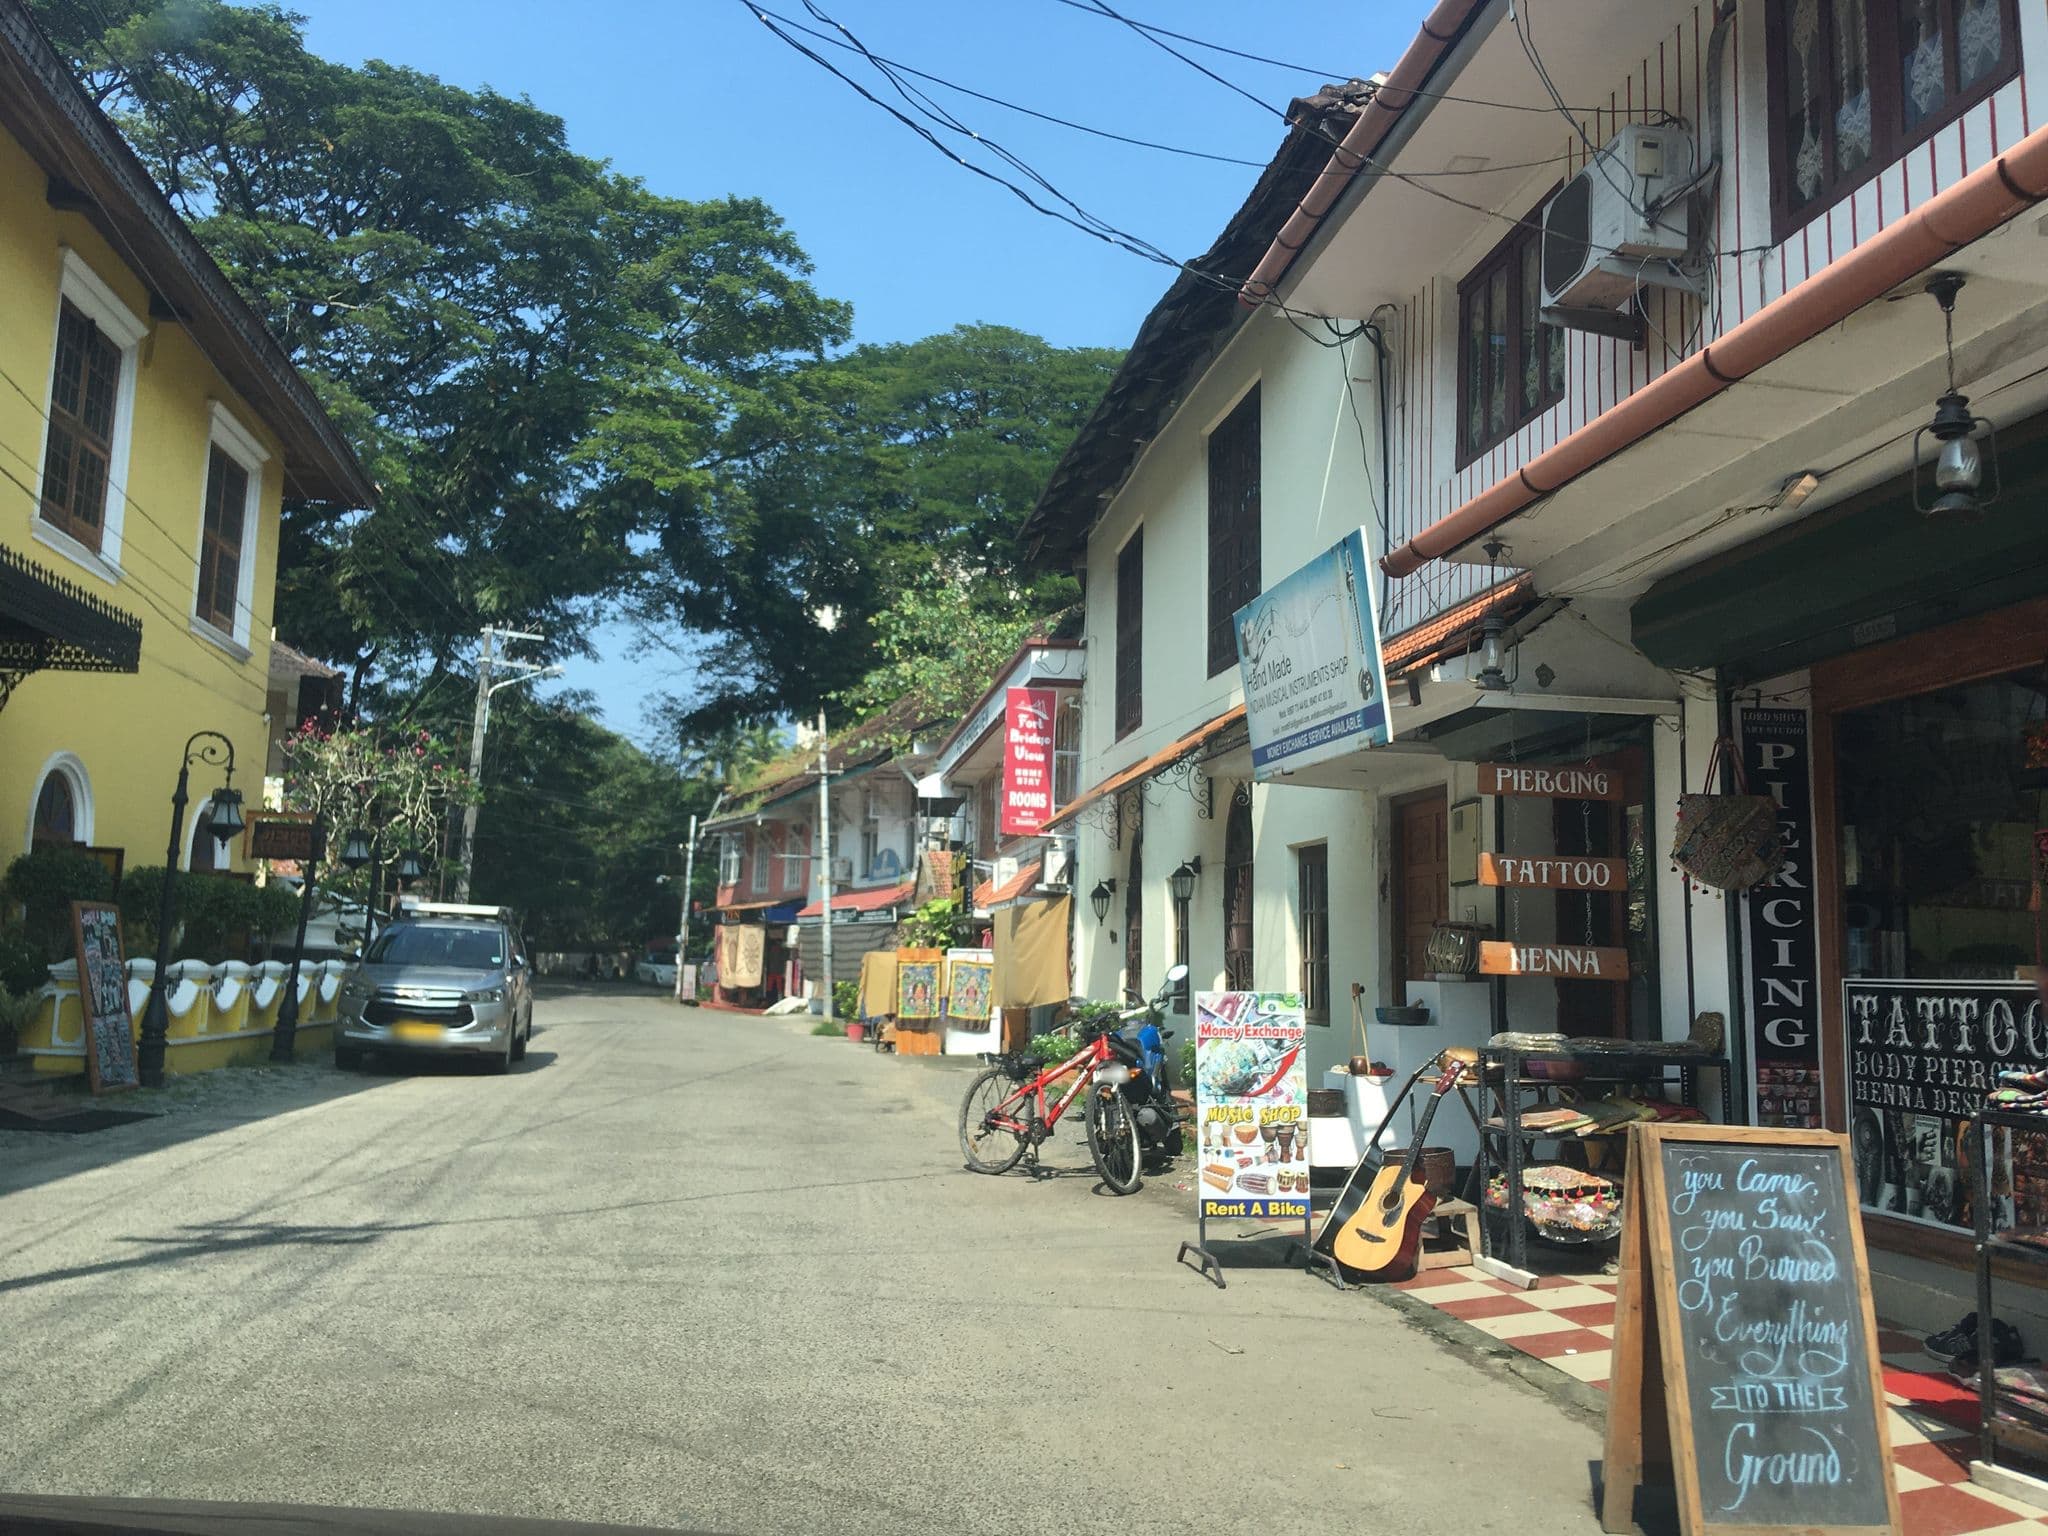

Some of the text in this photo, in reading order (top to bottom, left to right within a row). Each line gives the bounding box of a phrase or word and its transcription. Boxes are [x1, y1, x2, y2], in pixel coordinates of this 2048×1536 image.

[1266, 685, 1288, 707] MUSICAL
[1290, 665, 1330, 696] INSTRUMENTS
[1330, 656, 1348, 679] SHOP
[1268, 655, 1292, 683] Made
[1018, 714, 1043, 729] Fort
[1743, 712, 1770, 721] LORD
[1009, 728, 1050, 746] Bridge
[1266, 745, 1282, 760] MONEY
[1282, 734, 1308, 754] EXCHANGE
[1308, 725, 1331, 744] SERVICE
[1331, 714, 1361, 738] AVAILABLE
[1496, 768, 1608, 795] PIERCING
[1009, 791, 1047, 808] ROOMS
[1500, 859, 1610, 887] TATTOO
[1510, 948, 1600, 975] HENNA
[1200, 1024, 1303, 1039] Money Exchange
[1855, 1051, 1917, 1081] BODY
[1855, 1080, 1926, 1109] HENNA
[1207, 1106, 1301, 1124] MUSIC SHOP
[1672, 1169, 1725, 1215] you
[1206, 1202, 1306, 1215] Rent A Bike
[1681, 1208, 1747, 1251] you
[1716, 1292, 1848, 1378] Everything
[1742, 1382, 1816, 1408] TO THE
